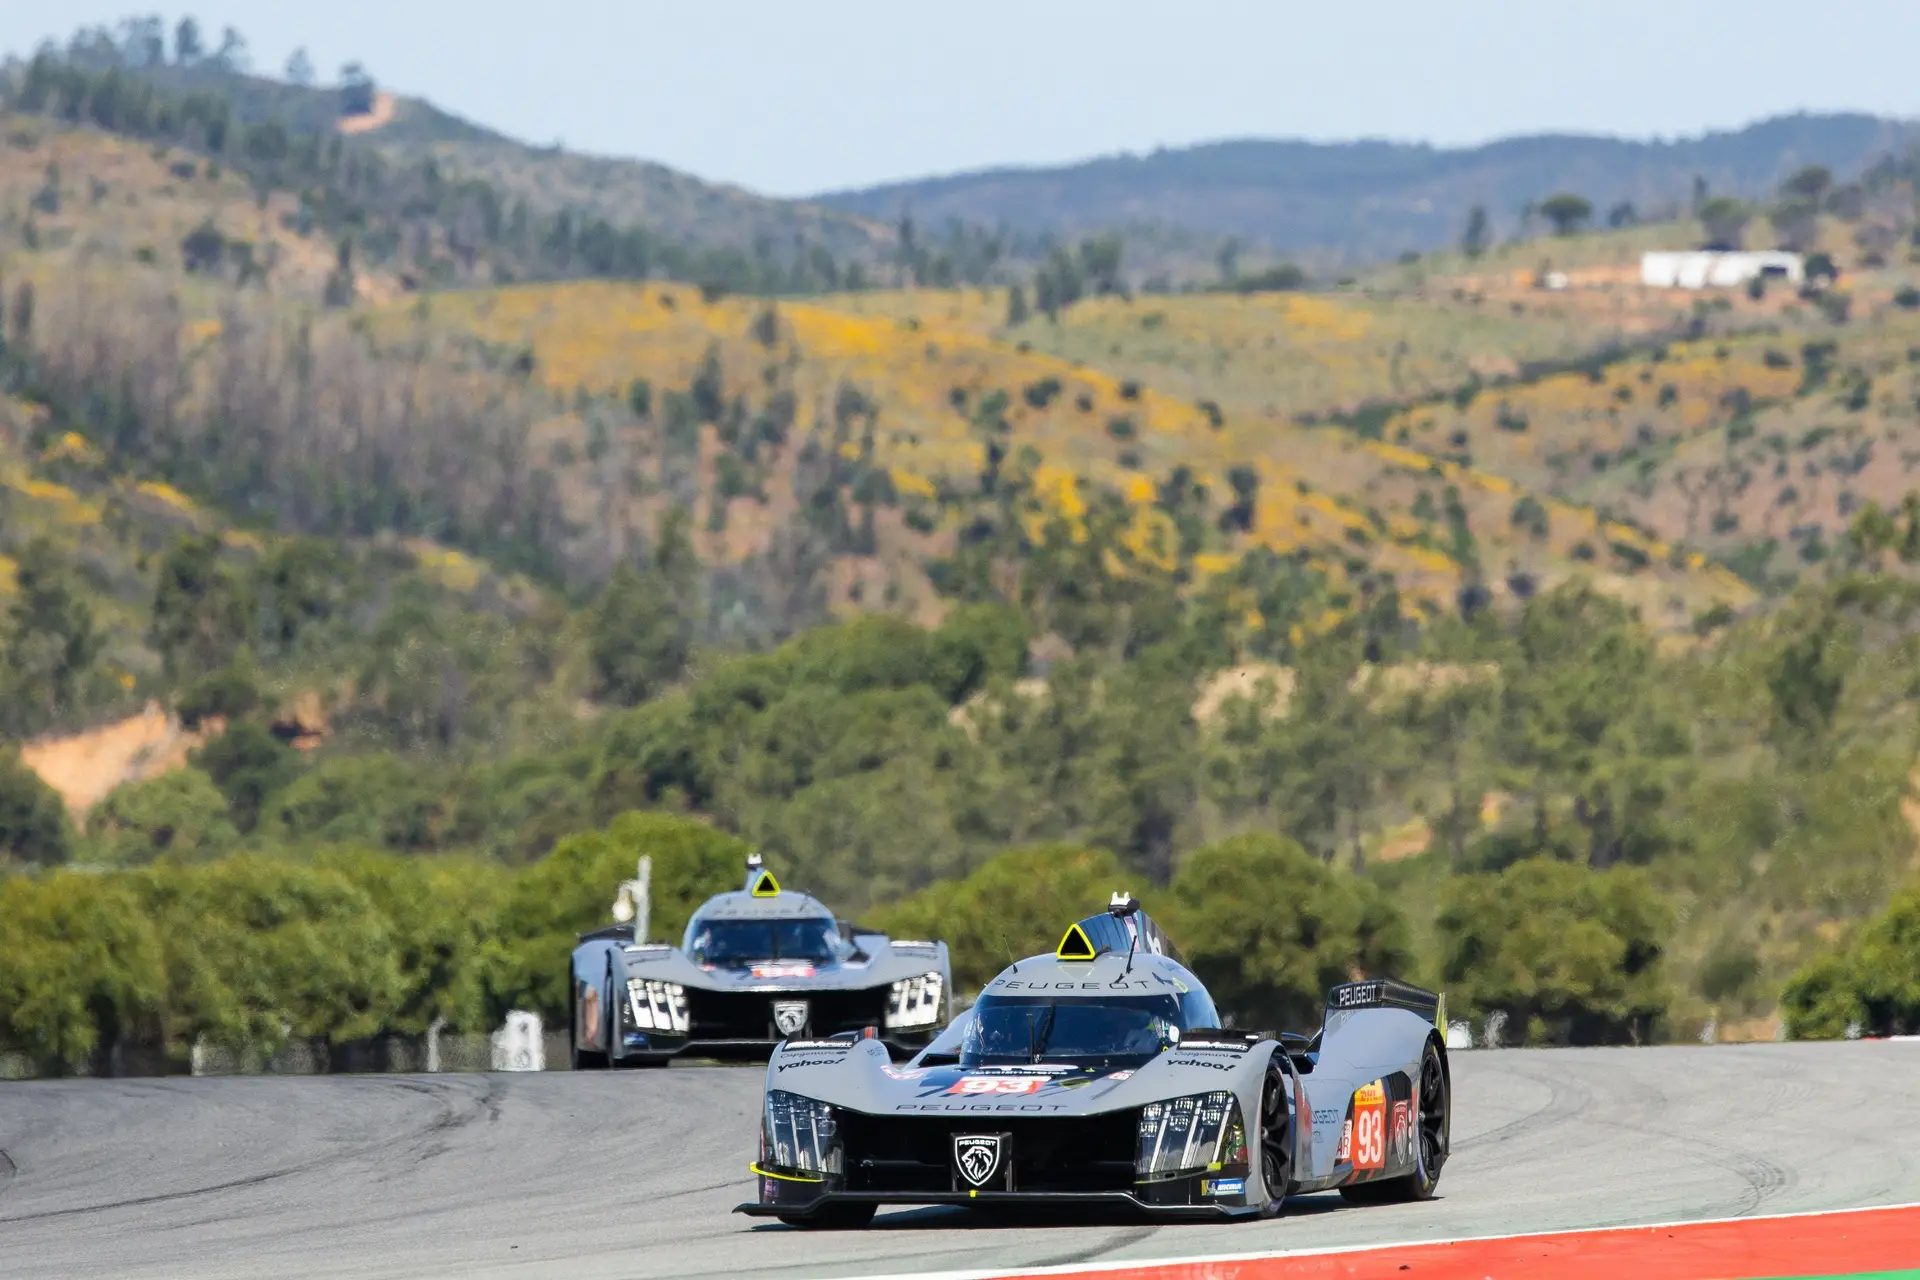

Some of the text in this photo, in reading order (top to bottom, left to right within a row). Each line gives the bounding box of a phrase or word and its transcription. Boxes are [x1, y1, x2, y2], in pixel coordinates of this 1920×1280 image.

[994, 979, 1149, 990] PEUGEOT
[1340, 984, 1377, 1007] PEUGEOT
[778, 1058, 846, 1073] yahoo!
[1167, 1059, 1236, 1071] yahoo!
[960, 1080, 1036, 1093] 93
[1358, 1110, 1383, 1164] 93
